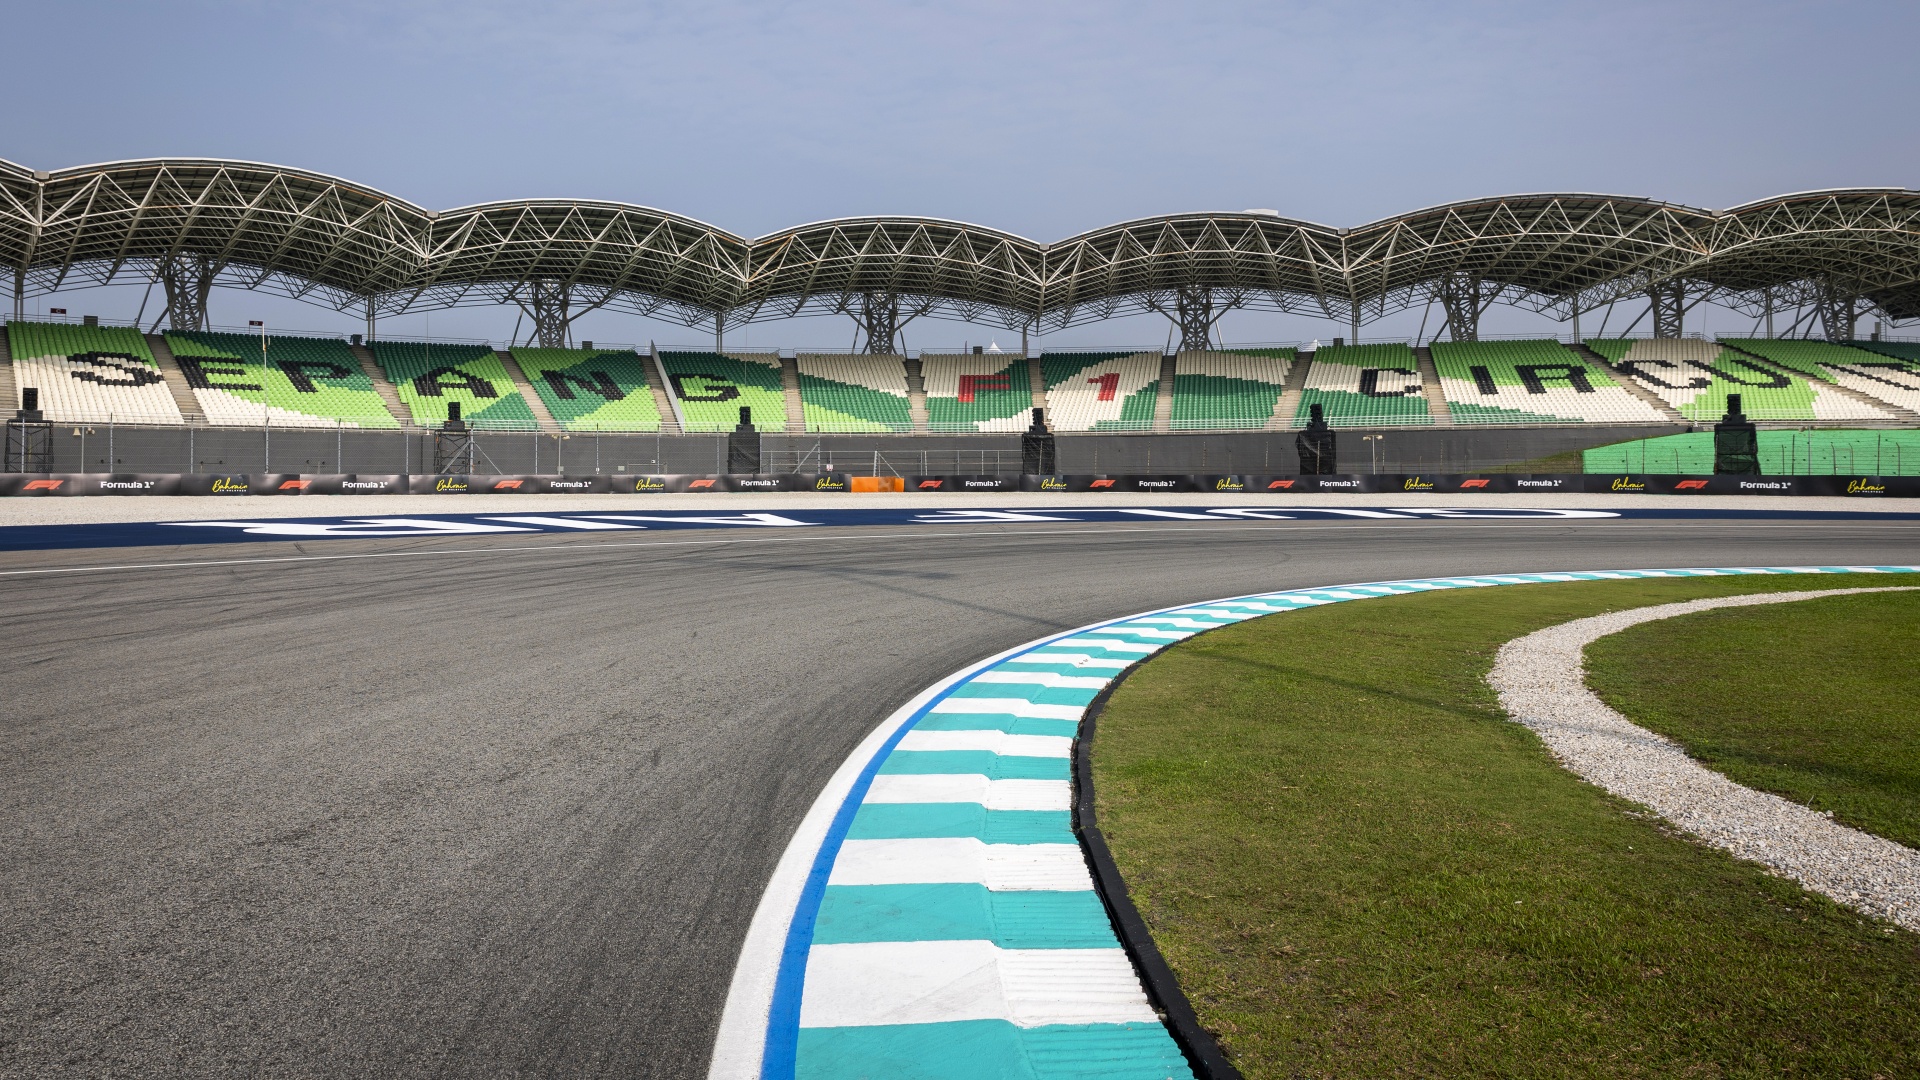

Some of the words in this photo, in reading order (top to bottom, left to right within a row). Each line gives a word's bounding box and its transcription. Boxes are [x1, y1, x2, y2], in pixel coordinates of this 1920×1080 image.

[66, 351, 741, 401] SEPANG
[958, 373, 1121, 402] F1
[100, 481, 143, 489] Formula
[212, 477, 248, 493] Bahrain
[436, 477, 468, 491] Bahrain
[636, 477, 665, 490] Bahrain
[816, 477, 844, 490] Bahrain
[1040, 477, 1067, 490] Bahrain
[1216, 478, 1244, 490] Bahrain
[1403, 477, 1434, 490] Bahrain
[1611, 477, 1645, 490] Bahrain
[1740, 481, 1780, 489] Formula
[1847, 477, 1886, 494] Bahrain
[907, 508, 1622, 523] GULF
[155, 513, 823, 536] AIR
